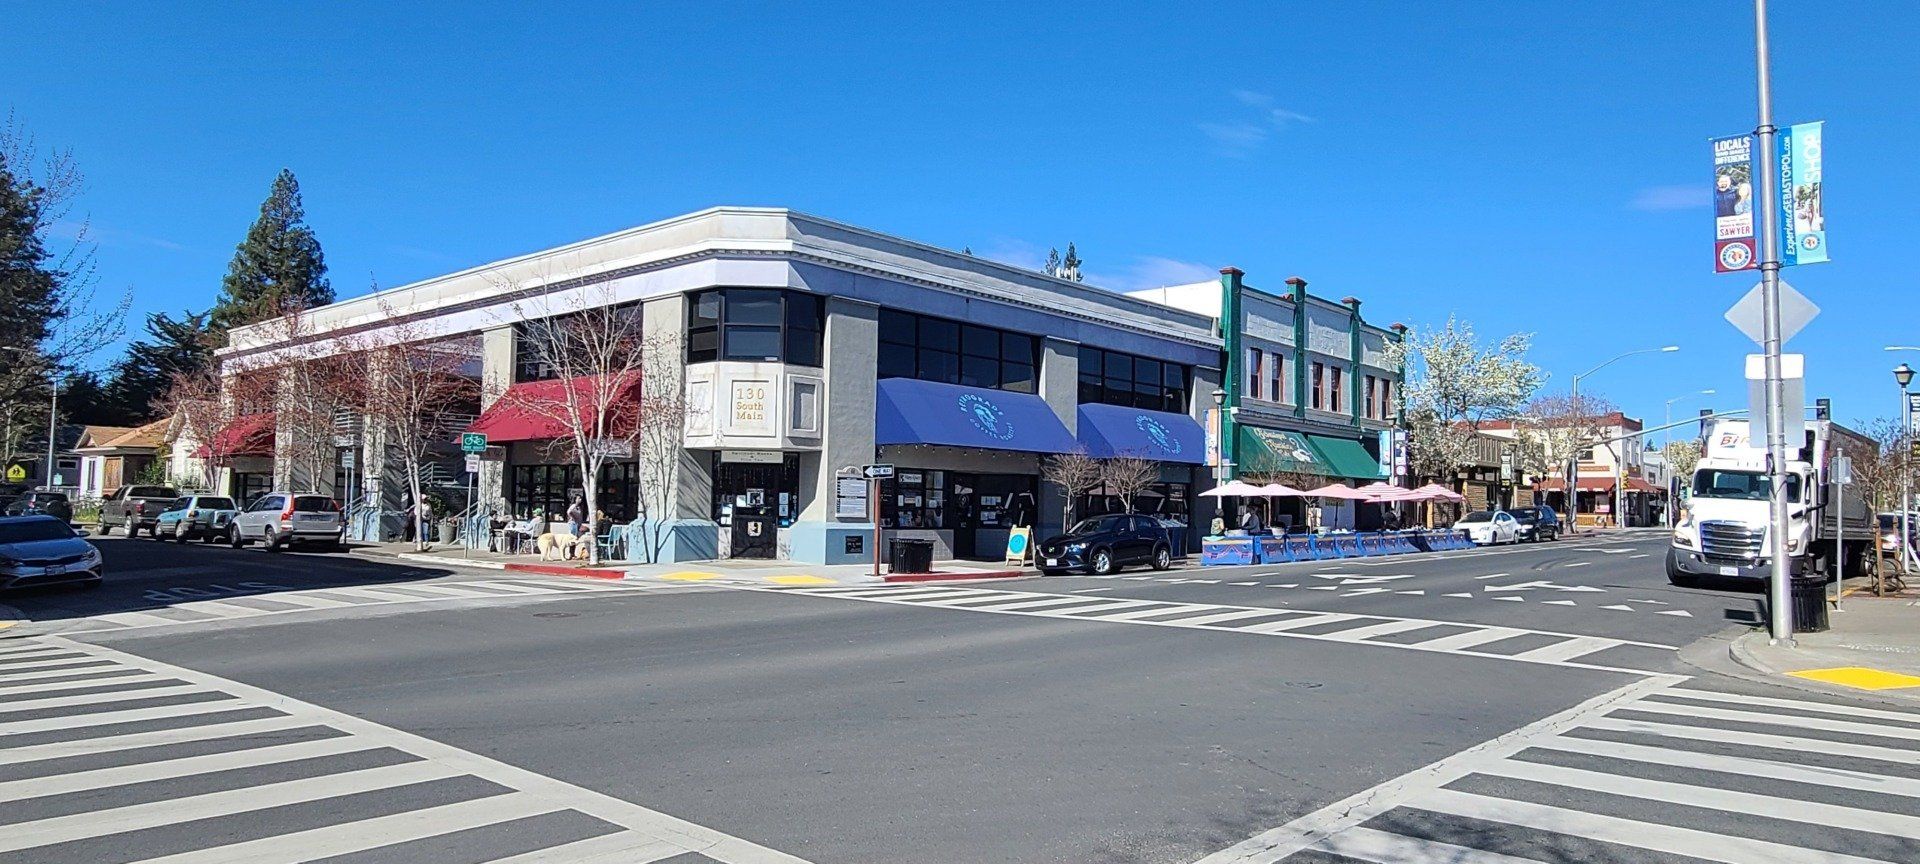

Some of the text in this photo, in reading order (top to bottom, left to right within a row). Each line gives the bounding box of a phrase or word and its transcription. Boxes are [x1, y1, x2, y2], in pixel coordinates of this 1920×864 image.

[1714, 136, 1751, 153] LOCALS
[1715, 153, 1750, 165] DIFFERENCE
[1804, 133, 1821, 183] SHOP
[1720, 225, 1751, 236] SAWYER
[736, 388, 765, 400] 130
[736, 401, 764, 411] South
[736, 411, 763, 420] Main
[873, 467, 881, 475] ONE
